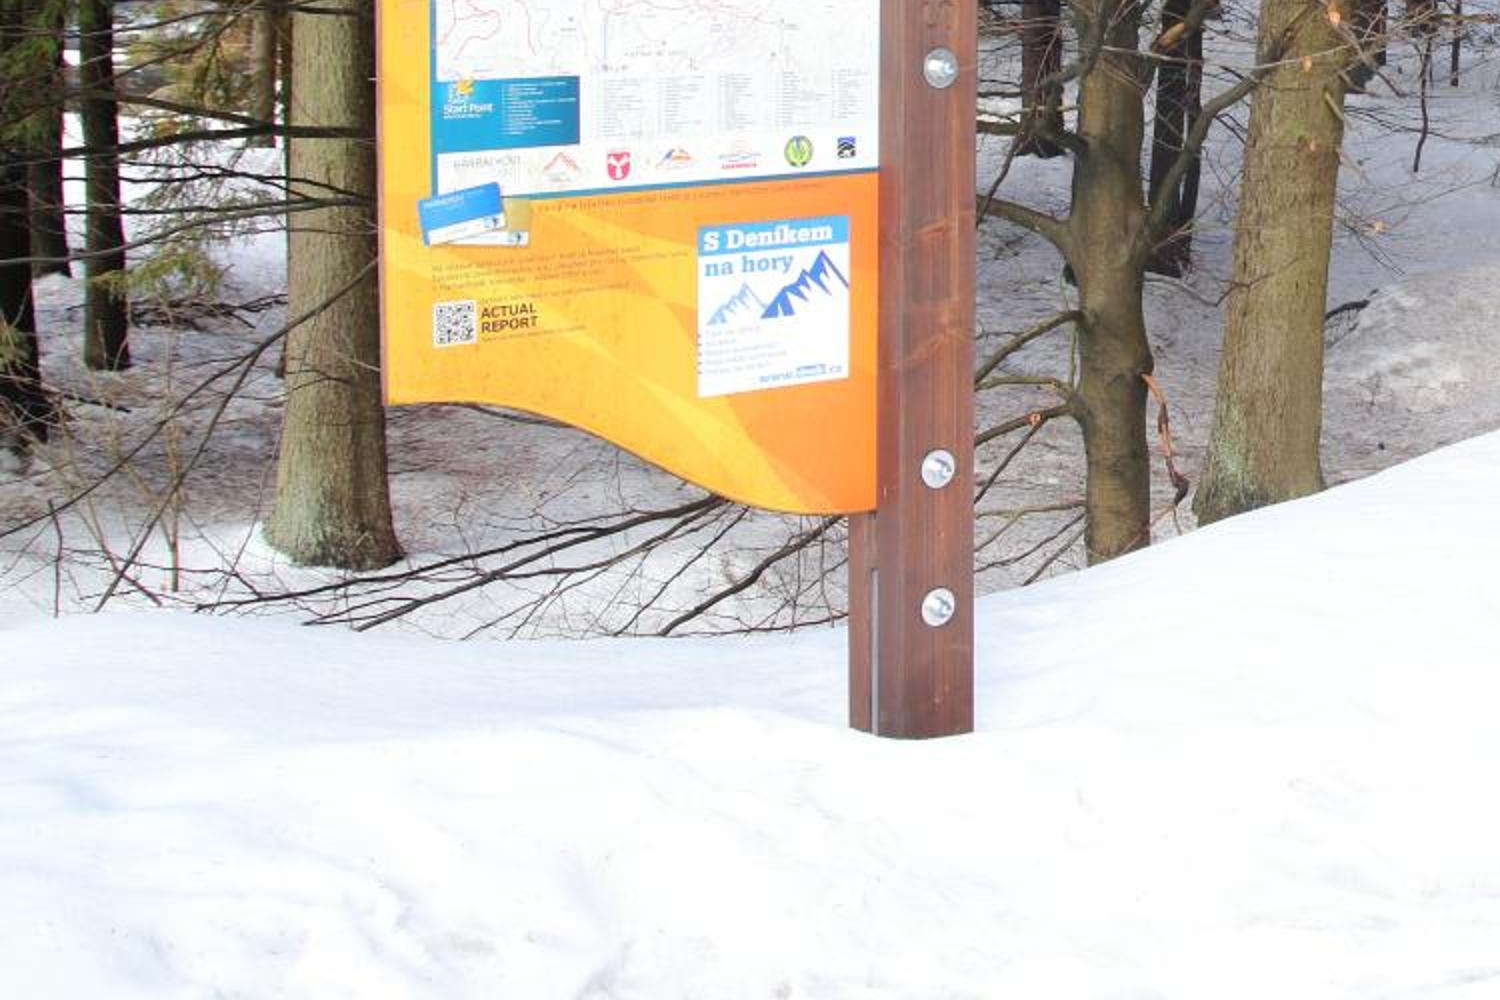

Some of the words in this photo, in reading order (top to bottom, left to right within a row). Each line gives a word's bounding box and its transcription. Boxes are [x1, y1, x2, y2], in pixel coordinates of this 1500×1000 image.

[703, 231, 720, 251] S
[704, 260, 734, 277] na
[741, 254, 794, 275] hory
[481, 303, 537, 319] ACTUAL
[481, 316, 538, 333] REPORT
